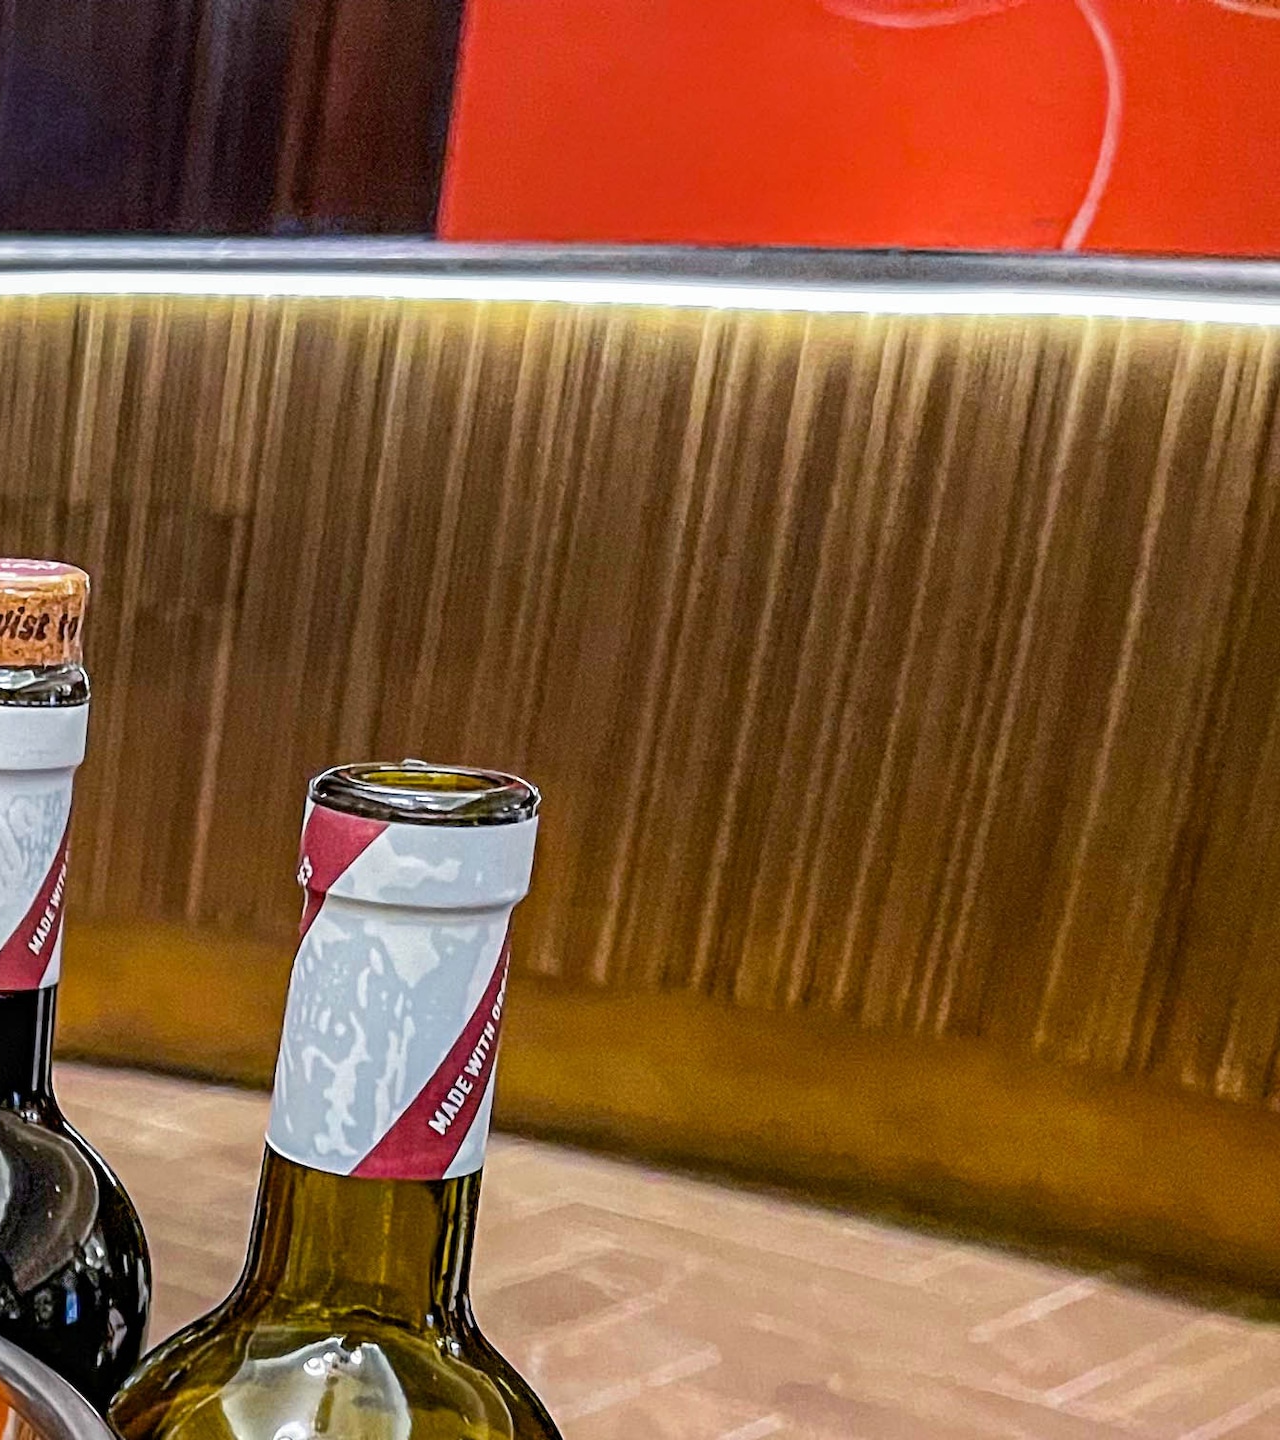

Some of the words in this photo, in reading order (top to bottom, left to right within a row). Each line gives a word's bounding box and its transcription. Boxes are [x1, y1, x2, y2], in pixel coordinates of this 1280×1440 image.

[28, 905, 56, 955] MADE
[428, 1074, 474, 1136] MADE
[463, 1020, 496, 1078] WITH
